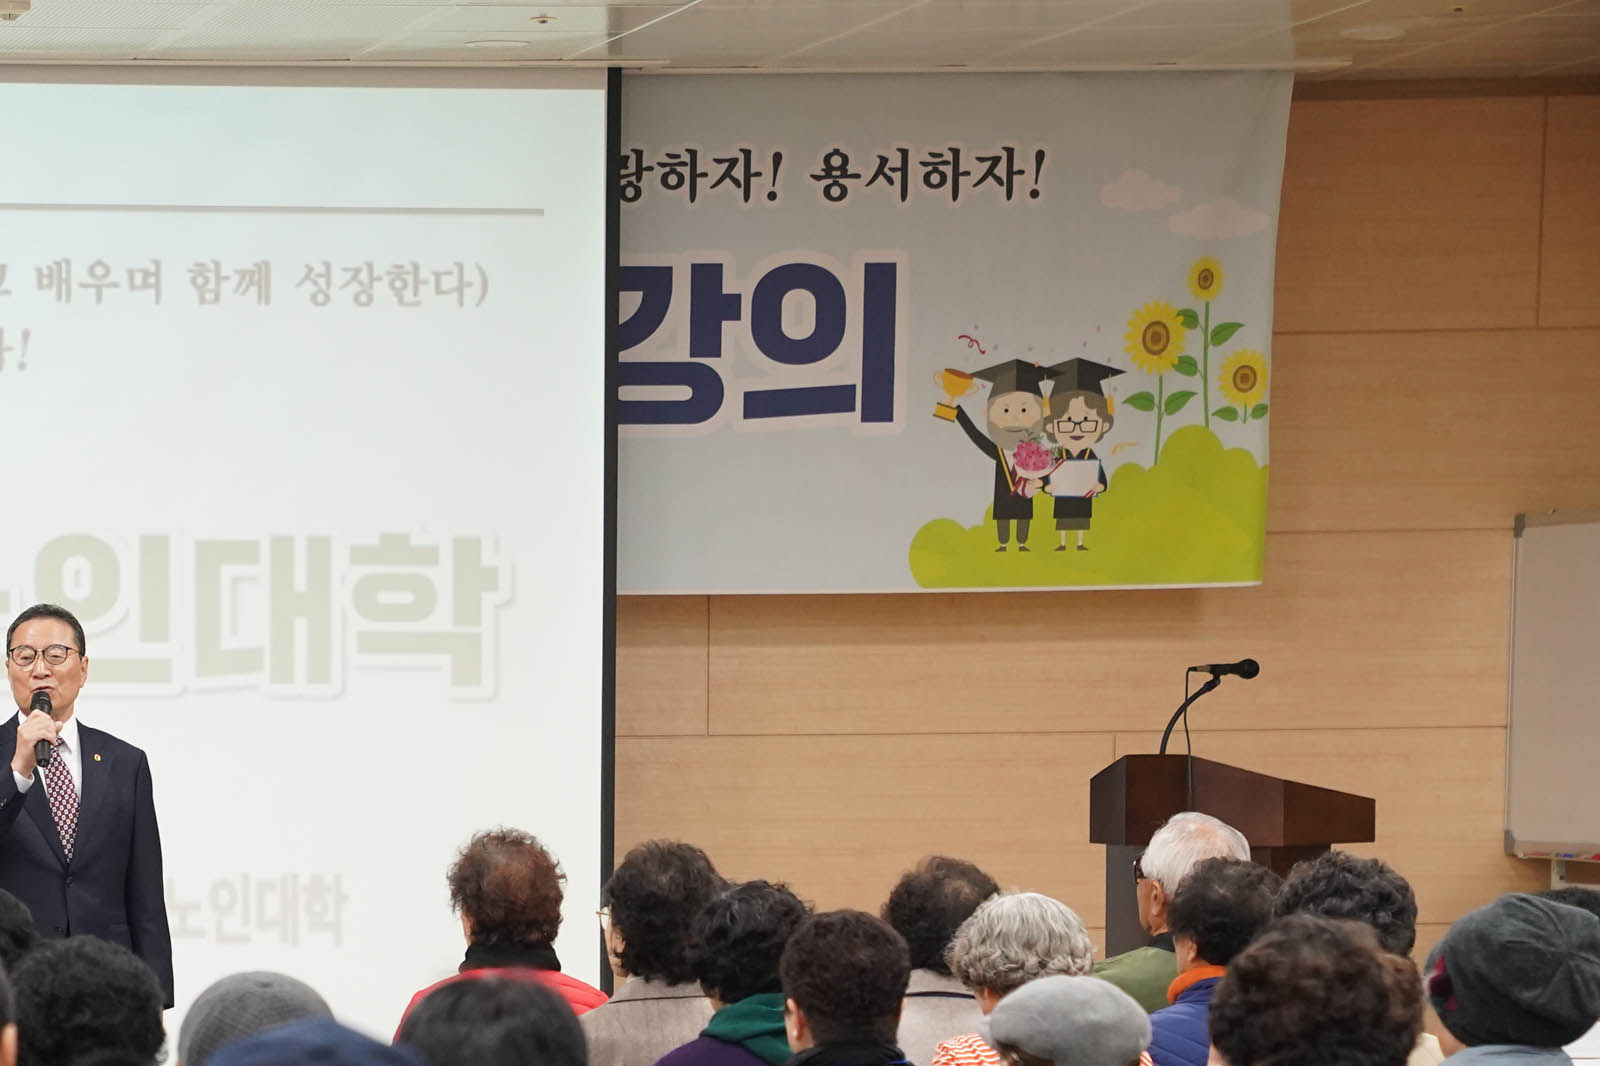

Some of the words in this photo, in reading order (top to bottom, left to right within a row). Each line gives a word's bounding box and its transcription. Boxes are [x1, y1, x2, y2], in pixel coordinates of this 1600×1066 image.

[809, 147, 1047, 204] 용서하자!
[35, 257, 164, 306] 배우며
[187, 259, 273, 308] 함께
[296, 261, 491, 310] 성장한다)
